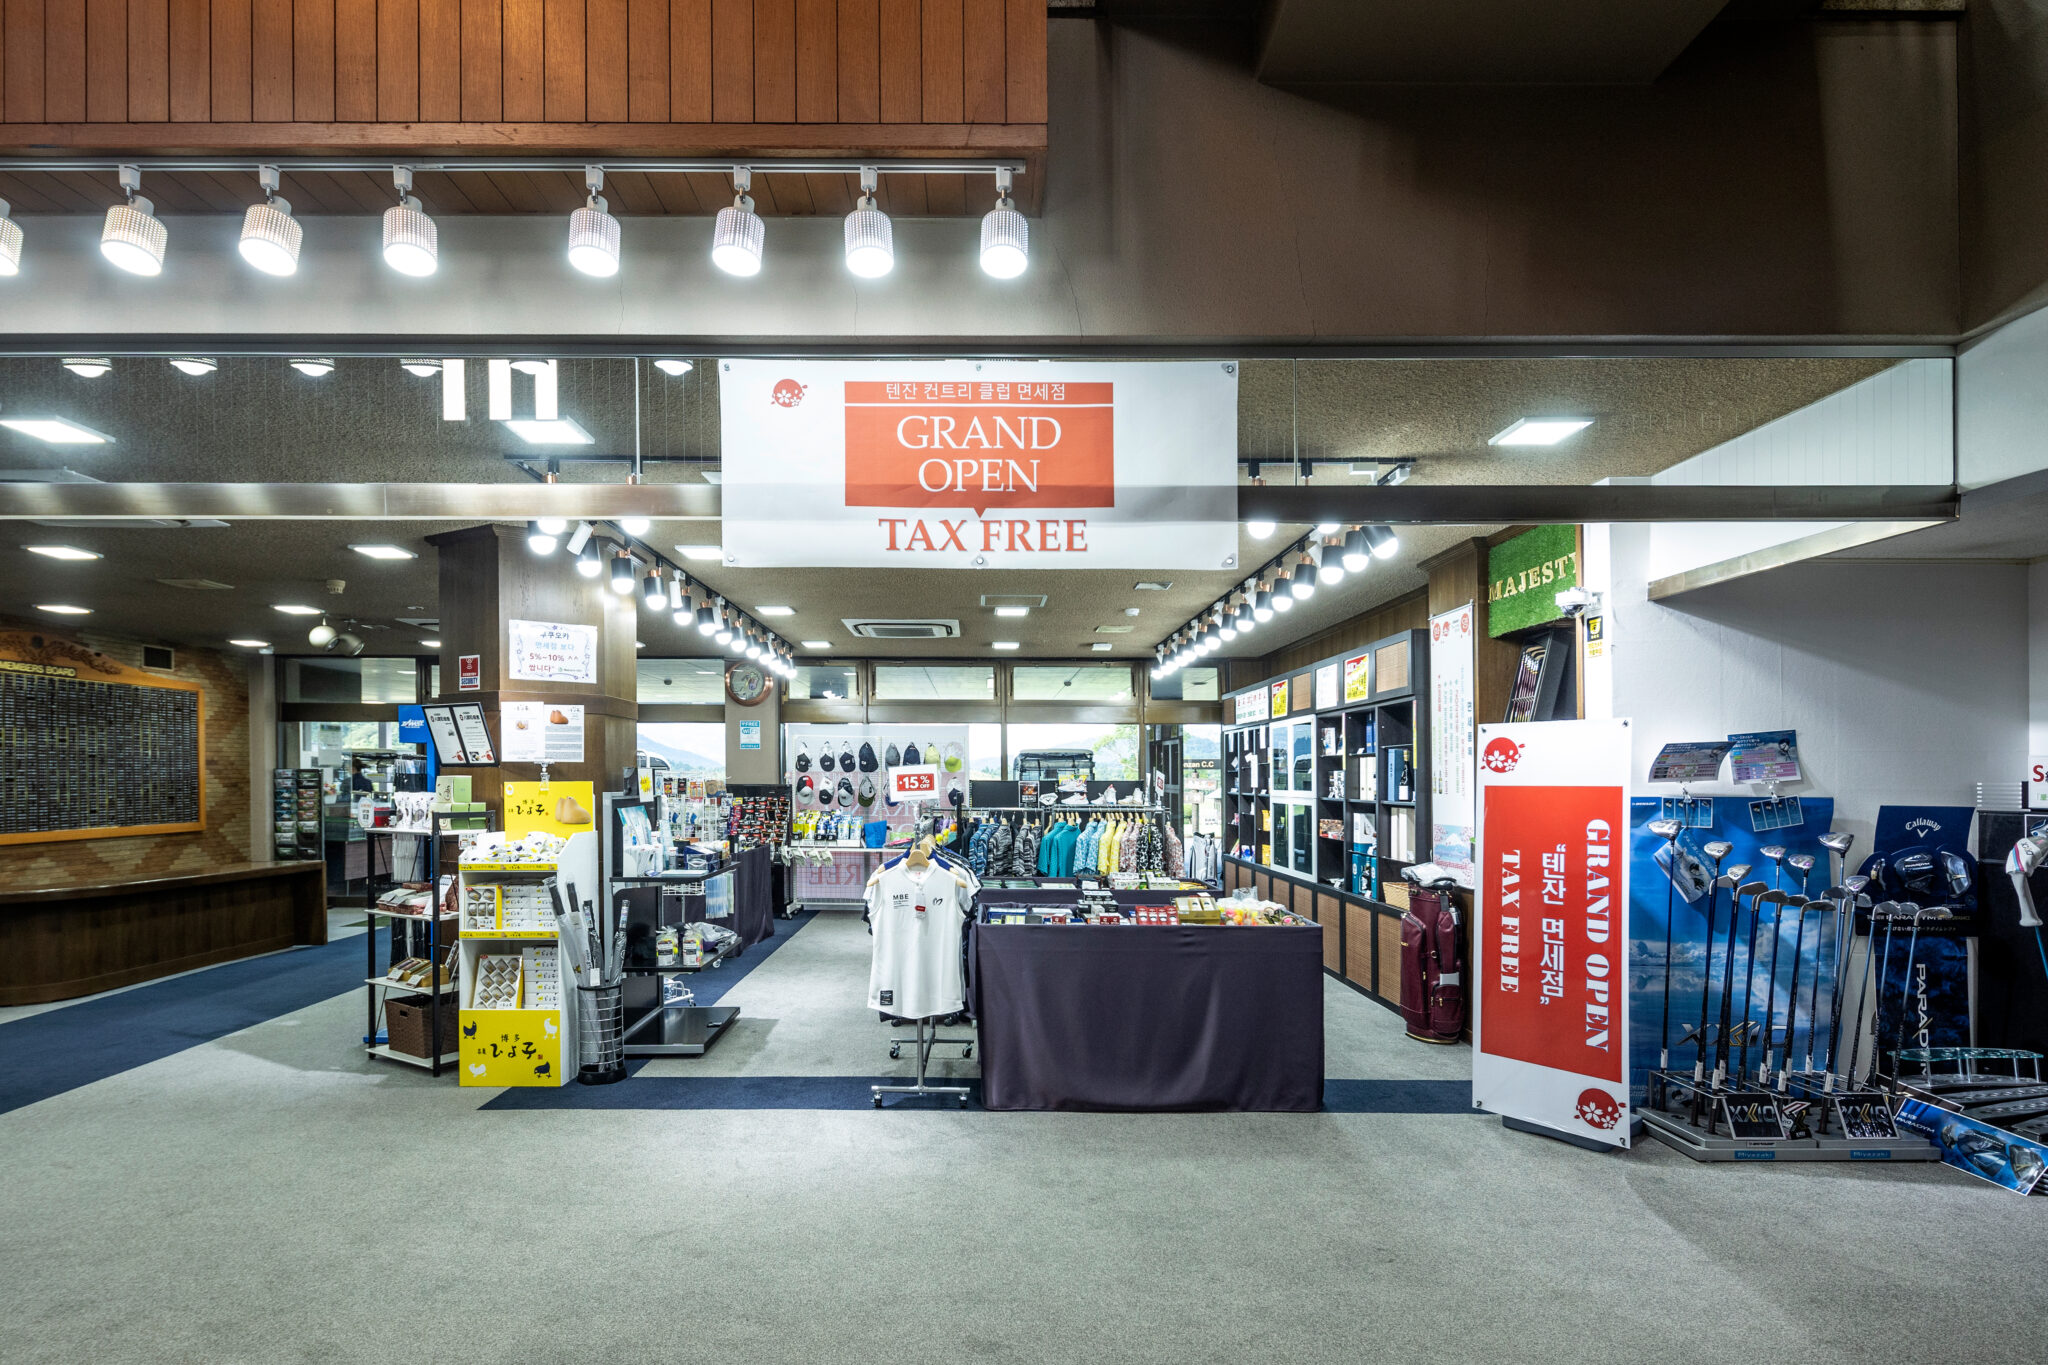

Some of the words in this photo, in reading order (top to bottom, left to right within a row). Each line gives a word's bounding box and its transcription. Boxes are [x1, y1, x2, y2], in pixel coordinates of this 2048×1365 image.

[887, 382, 918, 401] 텐잔
[924, 382, 973, 401] 컨트리
[978, 382, 1011, 401] 클럽
[1017, 382, 1066, 401] 면세점
[896, 415, 1062, 450] GRAND
[917, 458, 1041, 493] OPEN
[878, 518, 969, 552] TAX
[979, 518, 1089, 553] FREE
[535, 641, 558, 651] 면세점
[560, 643, 575, 652] 보다
[45, 665, 76, 677] BOARD
[1905, 817, 1942, 832] Callaway
[1500, 849, 1521, 908] TAX
[1586, 818, 1611, 944] GRAND
[1499, 916, 1520, 994] FREE
[1585, 952, 1610, 1053] OPEN
[490, 1041, 537, 1060] ひよ子
[1728, 1103, 1776, 1123] XXIO
[1840, 1103, 1888, 1123] XXIO
[1896, 1117, 1936, 1133] PARADYM
[1737, 1151, 1773, 1159] Miyazaki
[1852, 1150, 1889, 1159] Miyazaki
